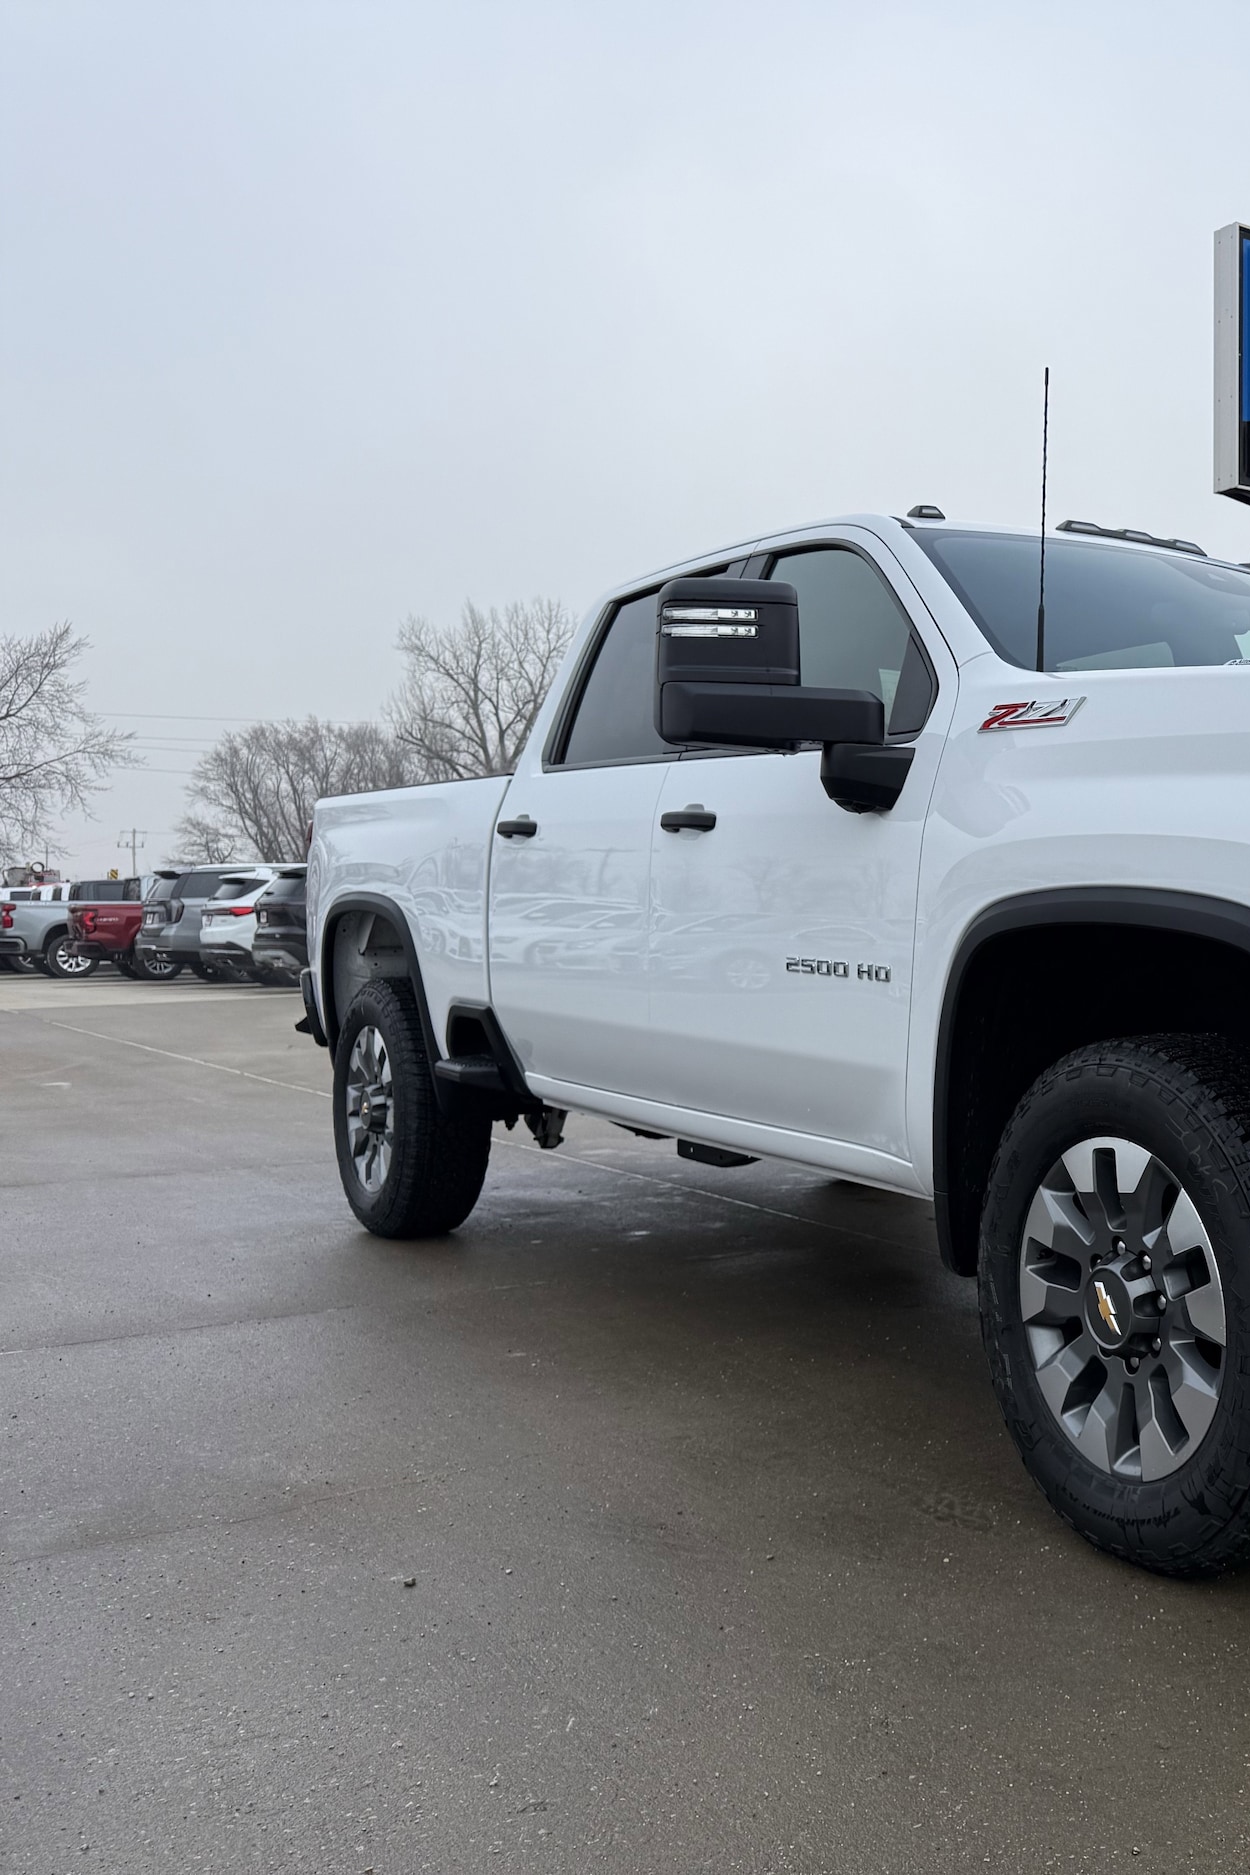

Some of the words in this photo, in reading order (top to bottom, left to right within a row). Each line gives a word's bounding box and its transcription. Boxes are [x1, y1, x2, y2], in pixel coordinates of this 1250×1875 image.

[977, 696, 1087, 734] Z71
[785, 956, 849, 978] 2500
[857, 962, 891, 983] HD
